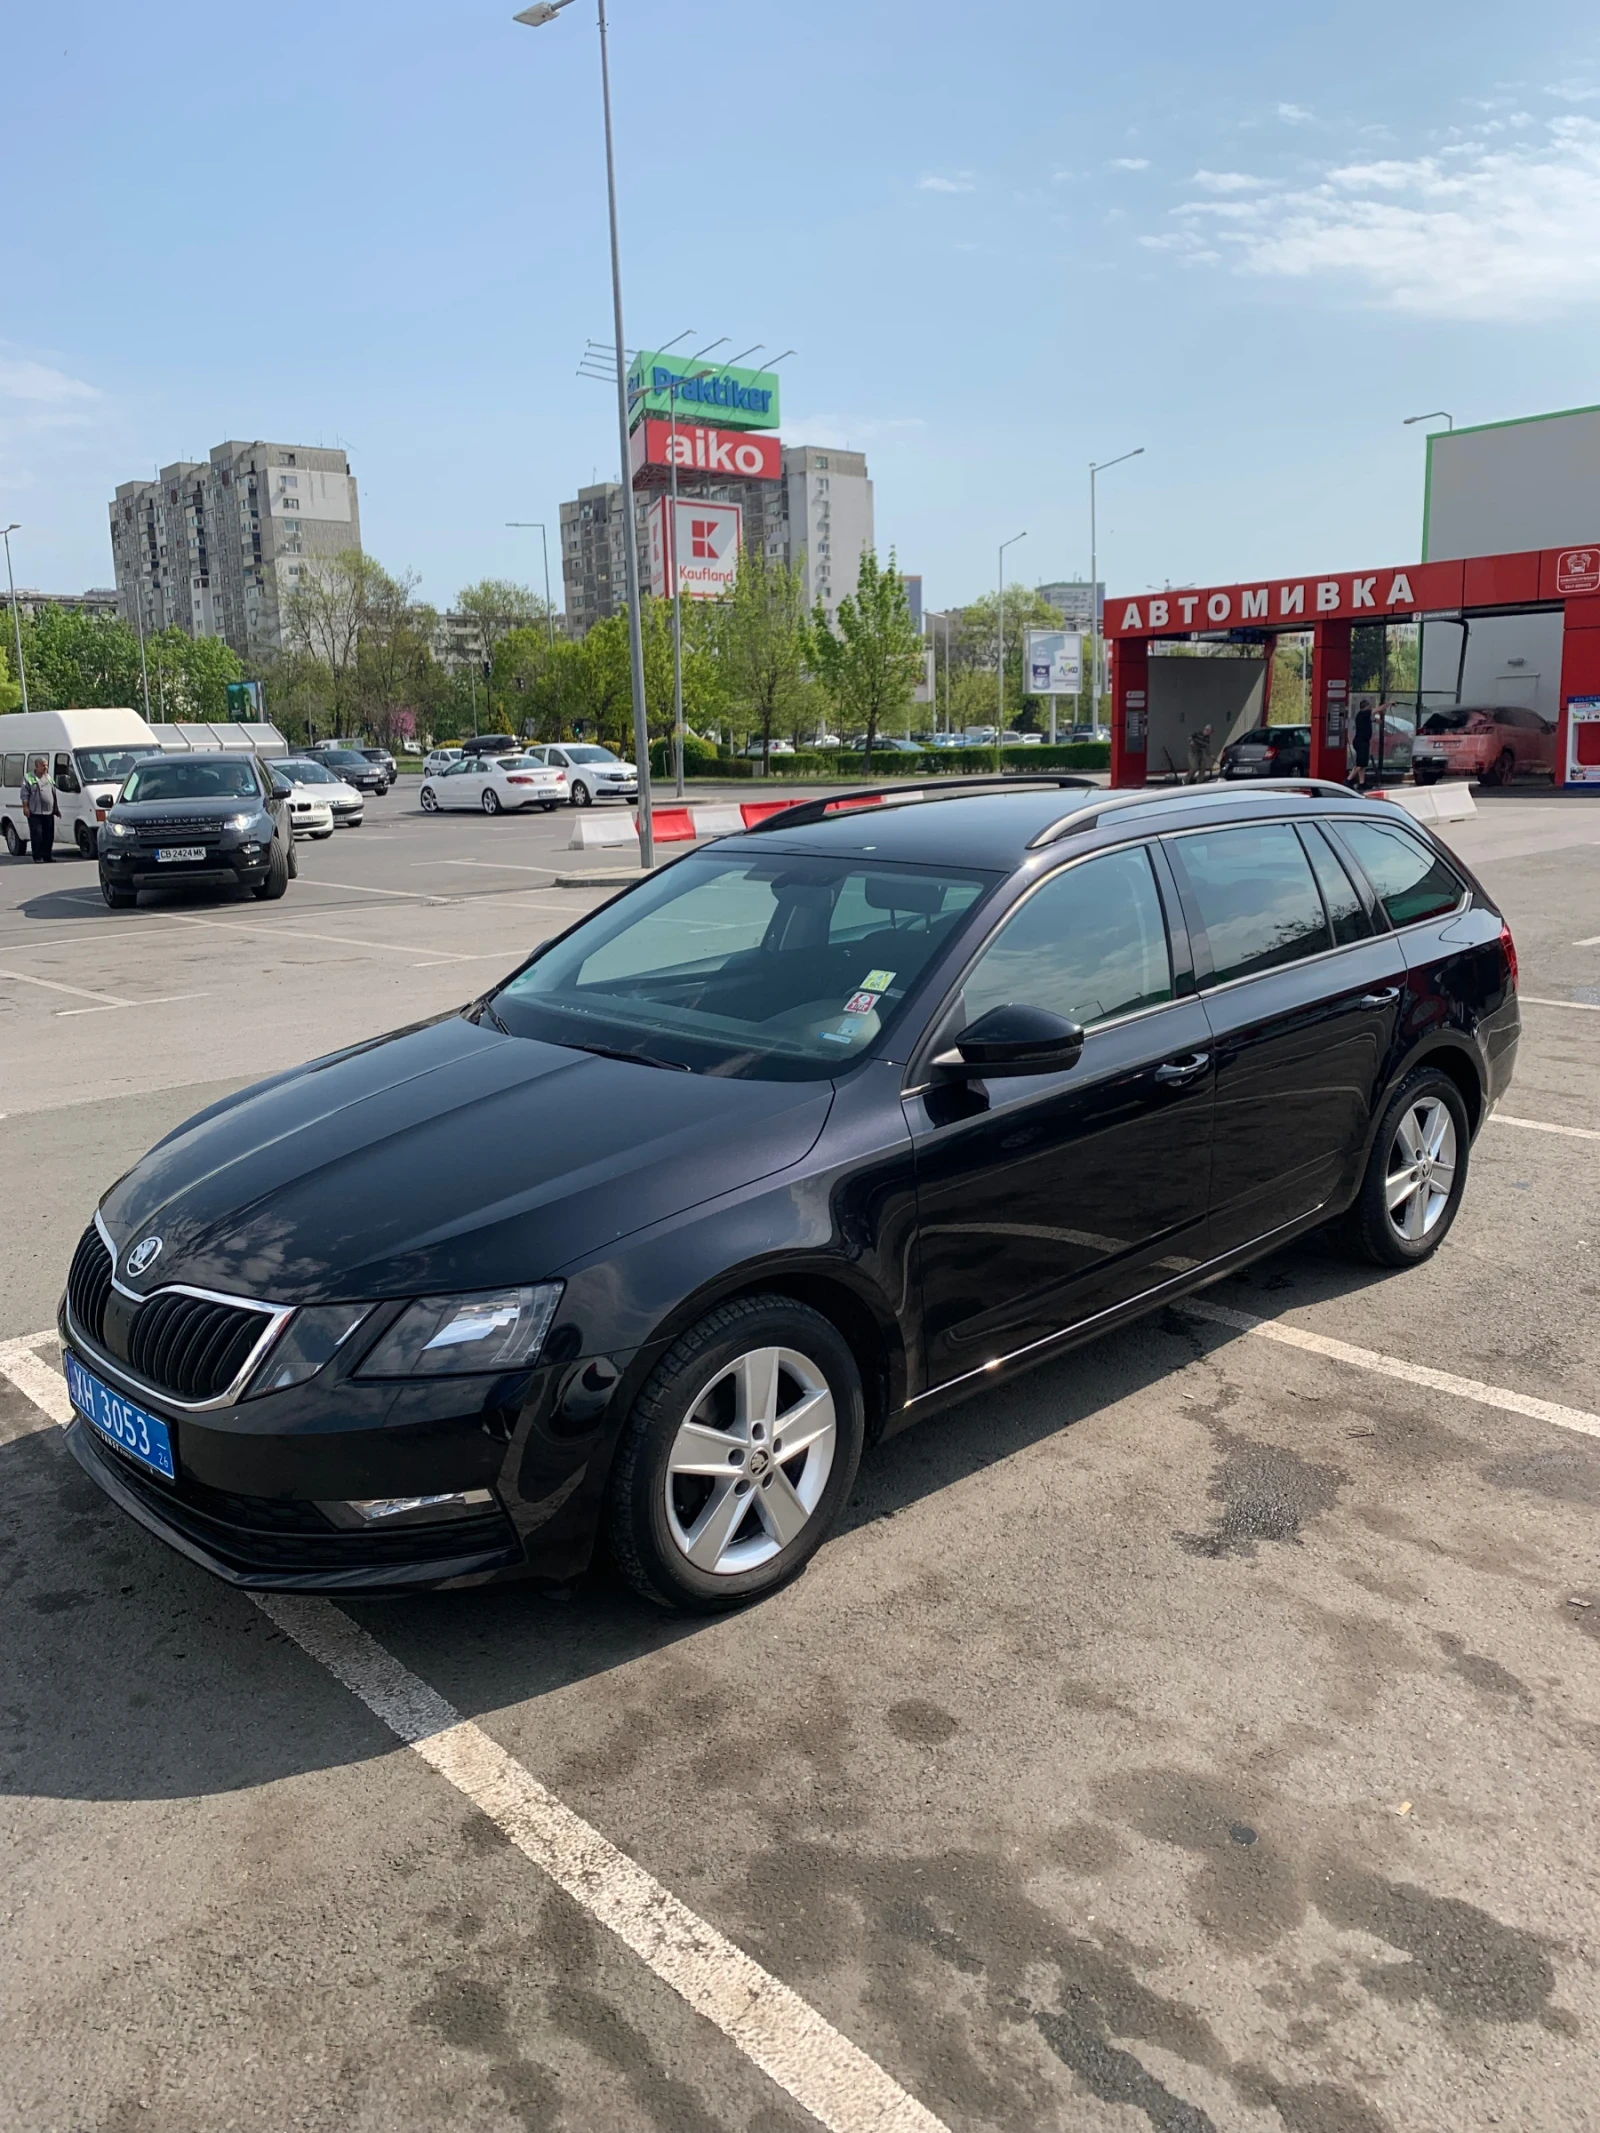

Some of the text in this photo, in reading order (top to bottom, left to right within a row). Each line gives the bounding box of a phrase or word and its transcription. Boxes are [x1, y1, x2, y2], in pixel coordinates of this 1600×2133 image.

[652, 366, 772, 413] Praktiker
[665, 429, 764, 474] aiko
[680, 565, 734, 582] Kaufland
[1120, 573, 1415, 630] АВТОМИВКА
[146, 817, 212, 825] DISCOVERY
[173, 849, 192, 858] 2424
[101, 1390, 151, 1455] 3053
